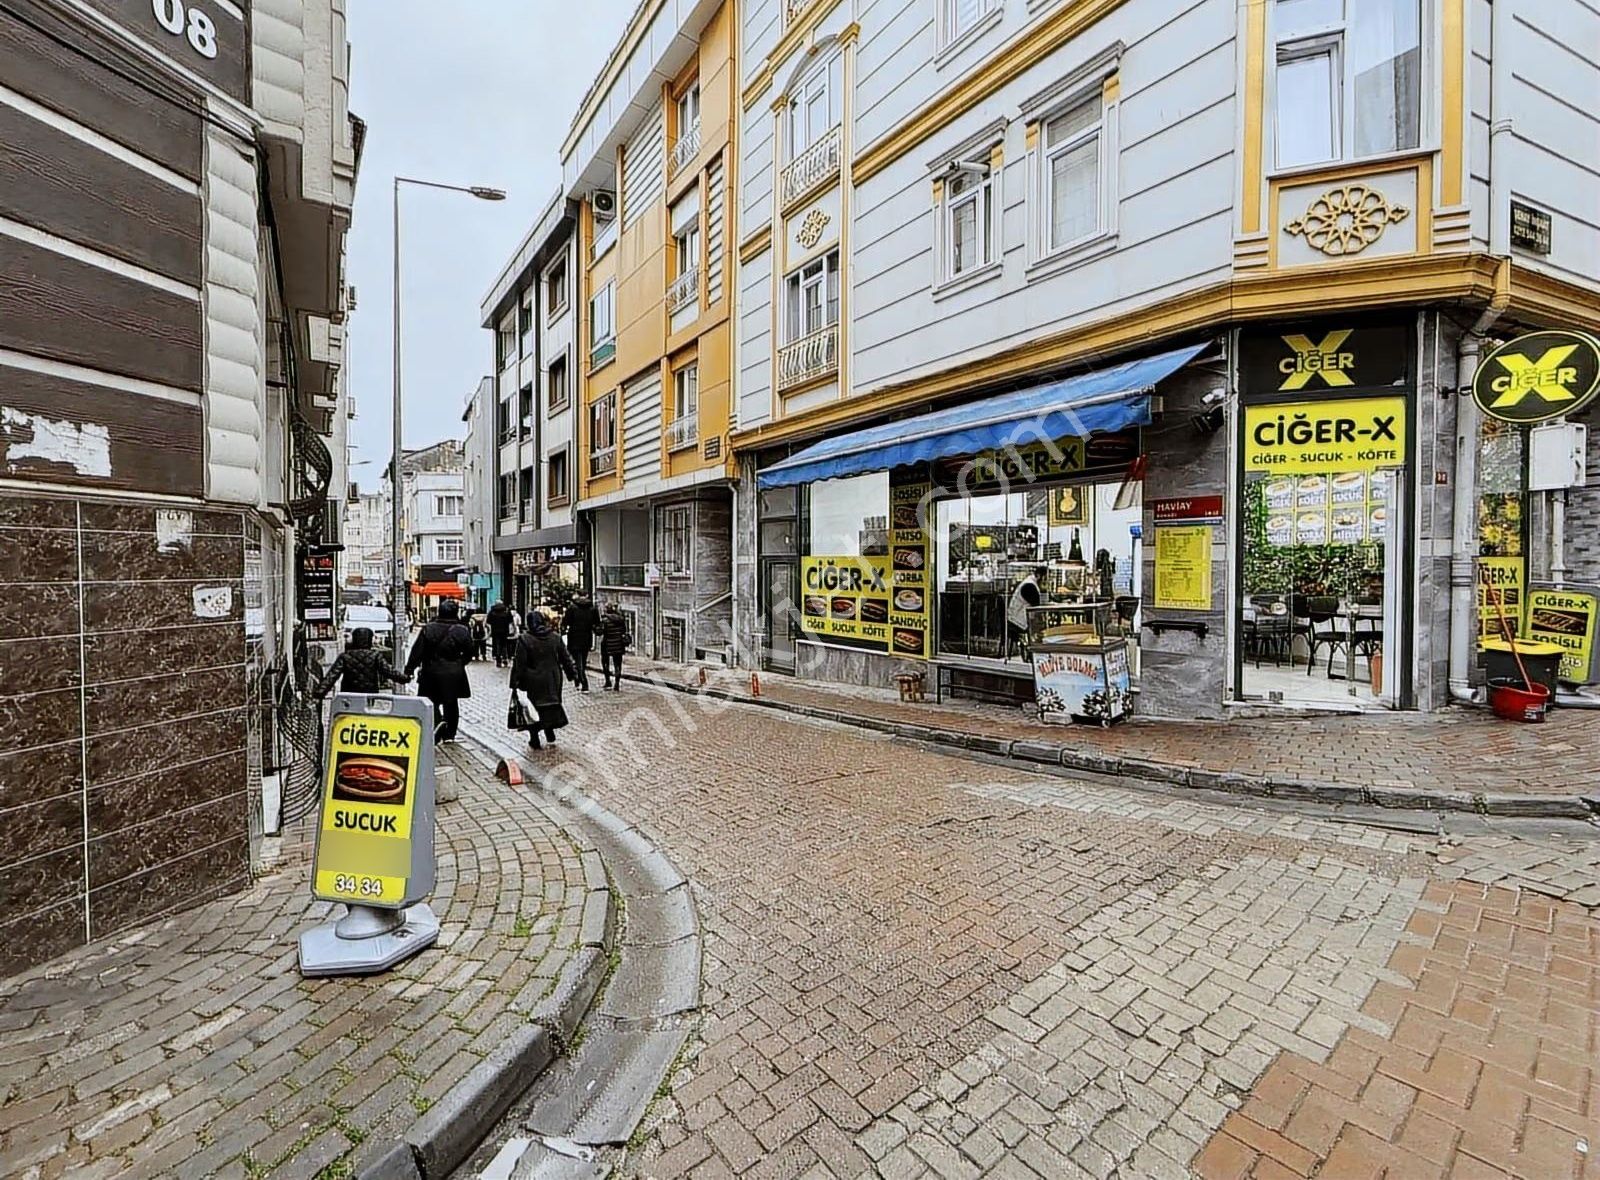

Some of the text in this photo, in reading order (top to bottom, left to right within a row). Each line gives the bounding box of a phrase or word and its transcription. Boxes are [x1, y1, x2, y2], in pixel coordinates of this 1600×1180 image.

[152, 0, 217, 59] 08
[1254, 413, 1396, 447] CİĞER-X
[1252, 453, 1287, 464] CİĞER
[1300, 452, 1343, 463] SUCUK
[1357, 449, 1397, 460] KÖFTE
[806, 560, 886, 592] CİĞER-X
[1535, 595, 1589, 608] CİĞER-X
[339, 724, 410, 749] CİĞER-X
[334, 810, 397, 833] SUCUK
[335, 874, 383, 897] 34 34
